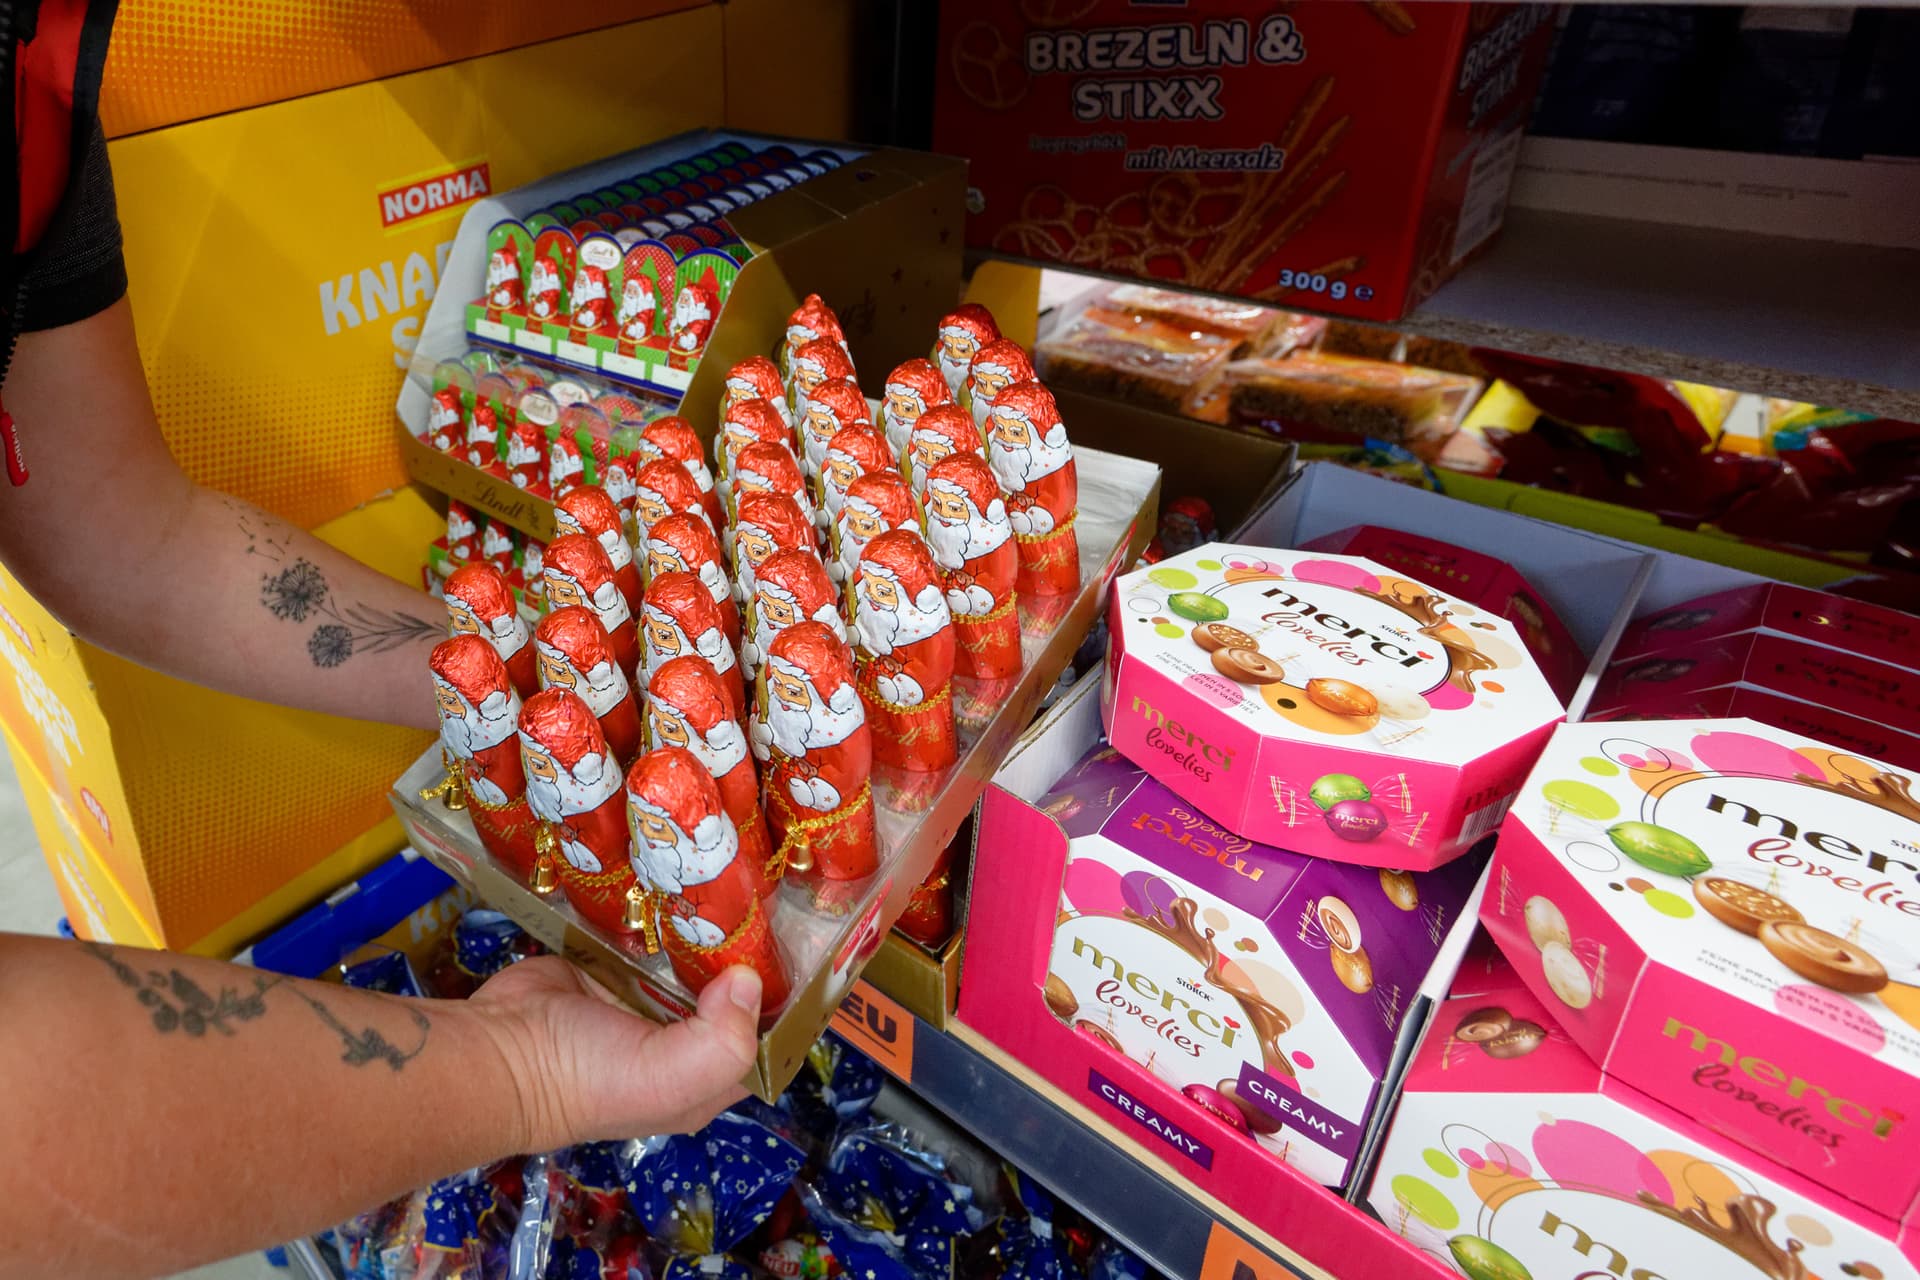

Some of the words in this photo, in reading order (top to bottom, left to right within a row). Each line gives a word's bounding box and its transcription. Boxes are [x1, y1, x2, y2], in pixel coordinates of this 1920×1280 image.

[1026, 22, 1248, 73] BREZELN
[1255, 15, 1306, 64] &
[1073, 76, 1225, 121] STIXX
[1125, 149, 1167, 170] mit
[1171, 144, 1284, 170] Meersalz
[382, 170, 487, 223] NORMA
[1279, 268, 1328, 293] 300
[1329, 280, 1348, 301] g
[475, 479, 527, 520] Lindt
[1260, 586, 1434, 668] merci
[1260, 610, 1374, 666] lovelies
[1379, 624, 1412, 642] STORCK
[1132, 694, 1236, 773] merci
[1145, 727, 1214, 783] lovelies
[1131, 811, 1265, 883] merci
[1167, 805, 1254, 855] lovelies
[1335, 812, 1379, 826] merci
[1705, 793, 1920, 886] mer
[1890, 839, 1920, 855] STO
[1747, 837, 1920, 918] lovelie
[1072, 935, 1240, 1049] merci
[1176, 976, 1212, 1002] STORCK
[839, 991, 898, 1044] EU
[1095, 979, 1206, 1059] lovelies
[1661, 1014, 1905, 1142] merci
[1692, 1061, 1846, 1150] lovelies
[1100, 1083, 1202, 1156] CREAMY
[1193, 1092, 1239, 1126] merci
[1246, 1078, 1345, 1142] CREAMY
[766, 1256, 796, 1274] NEU
